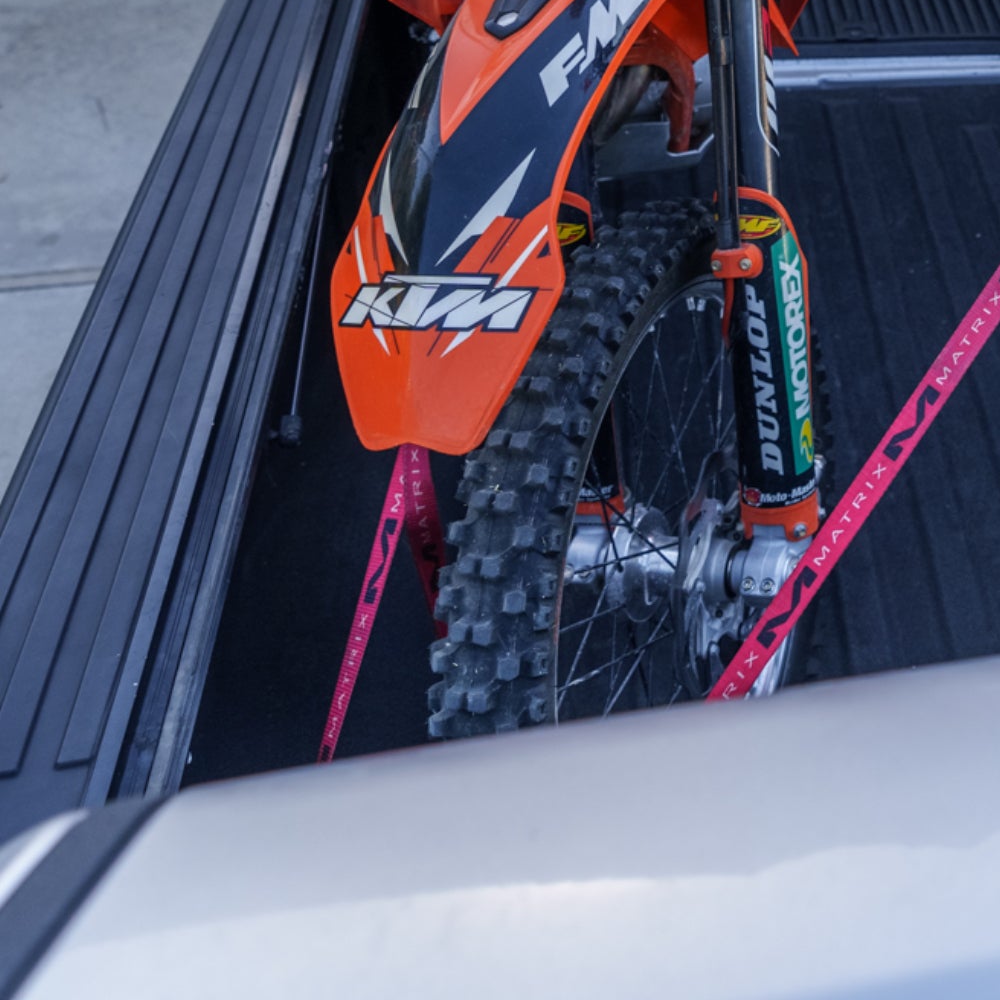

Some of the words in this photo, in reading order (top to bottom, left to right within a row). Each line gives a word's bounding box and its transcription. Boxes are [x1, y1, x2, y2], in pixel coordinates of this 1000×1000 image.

[338, 273, 537, 331] KTM
[778, 252, 810, 420] MOTOREX
[745, 284, 784, 476] DUNLOP
[813, 463, 887, 566] MATRIX
